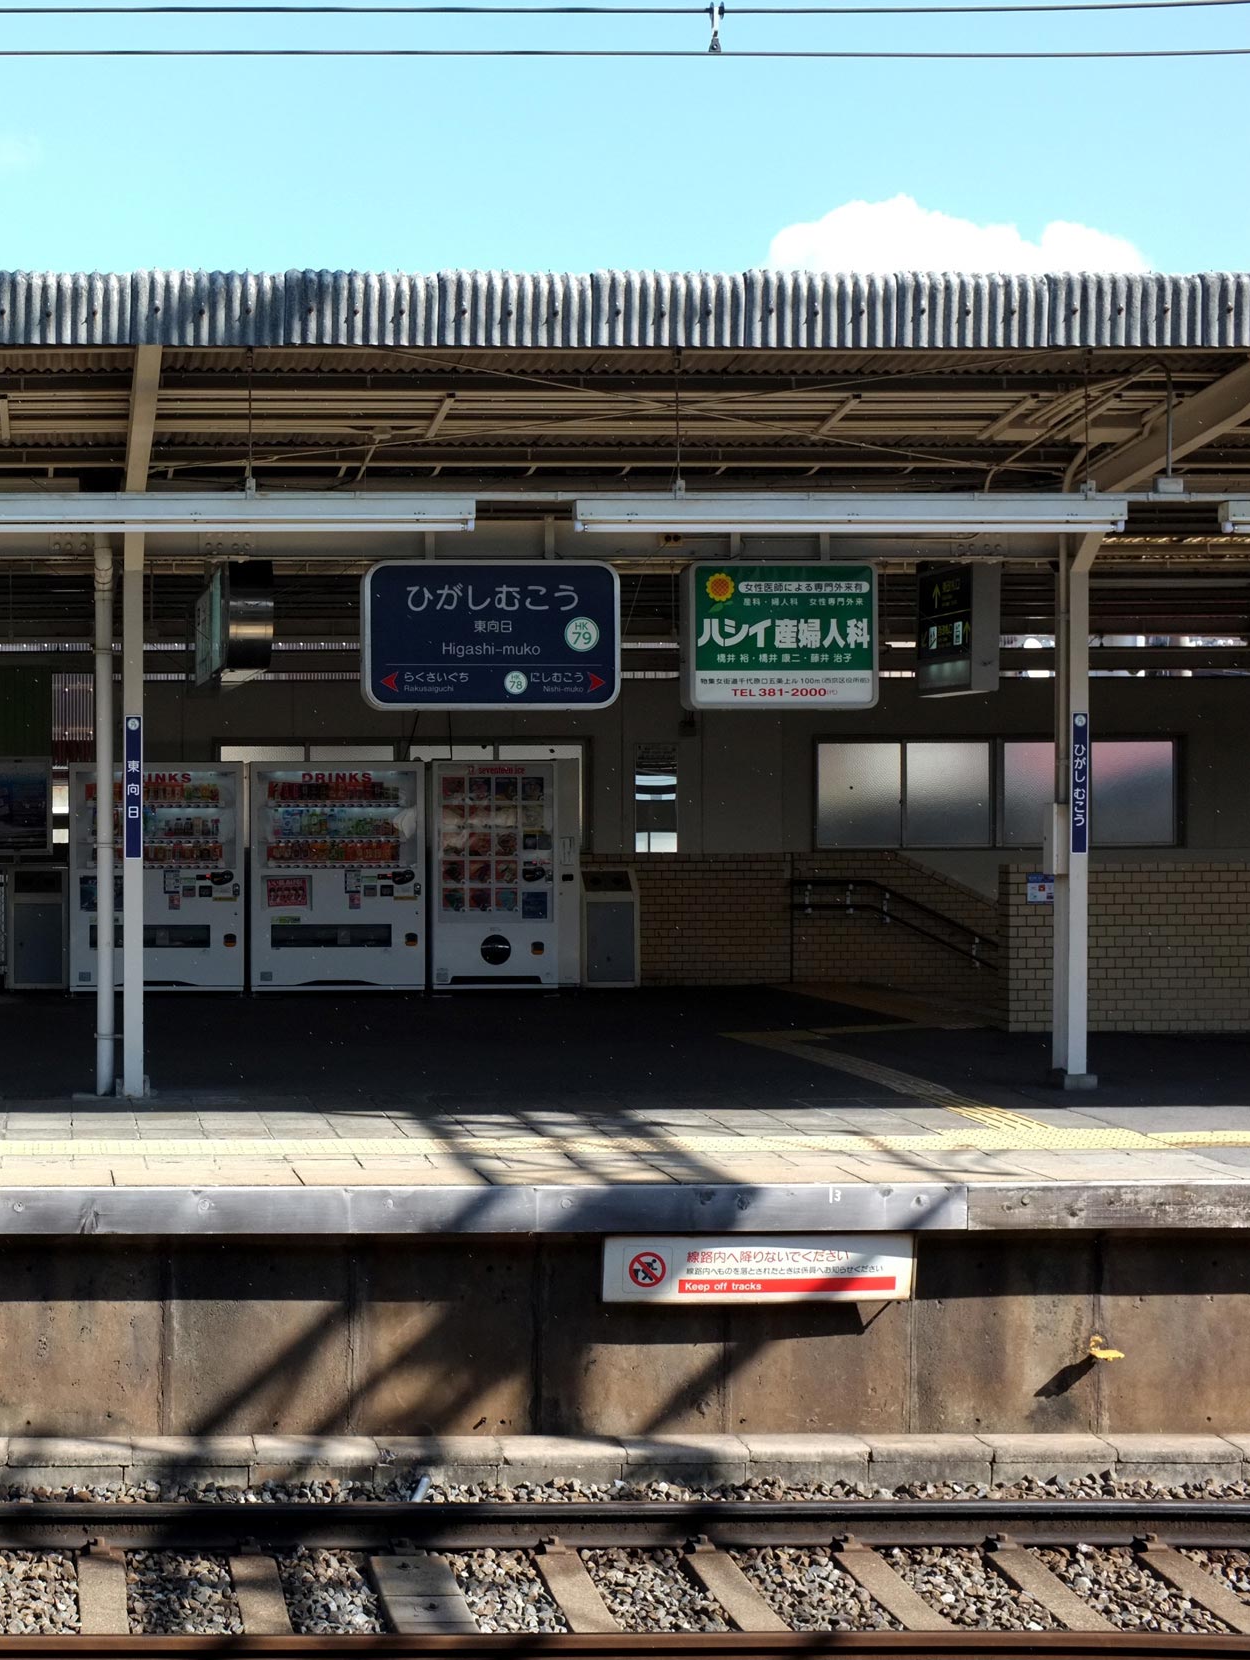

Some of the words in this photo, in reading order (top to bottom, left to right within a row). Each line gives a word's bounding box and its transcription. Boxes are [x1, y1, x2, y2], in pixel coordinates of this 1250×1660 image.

[406, 583, 579, 612] ひがしむこう
[473, 620, 512, 633] 東向日
[571, 632, 592, 645] 79
[697, 618, 871, 649] ハシイ産婦人科
[442, 642, 541, 658] Higashi-muko
[404, 672, 469, 683] らくさいぐち
[530, 672, 584, 683] にしむこう
[404, 684, 454, 694] Rakusaiguchi
[509, 681, 523, 690] 78
[543, 685, 584, 694] Nishi-muko
[301, 772, 372, 783] DRINKS
[127, 760, 140, 819] 東向日
[686, 1250, 850, 1264] 線路内へ降りないでください
[685, 1282, 710, 1292] Keep
[714, 1281, 728, 1291] off
[732, 1281, 762, 1291] tracks
